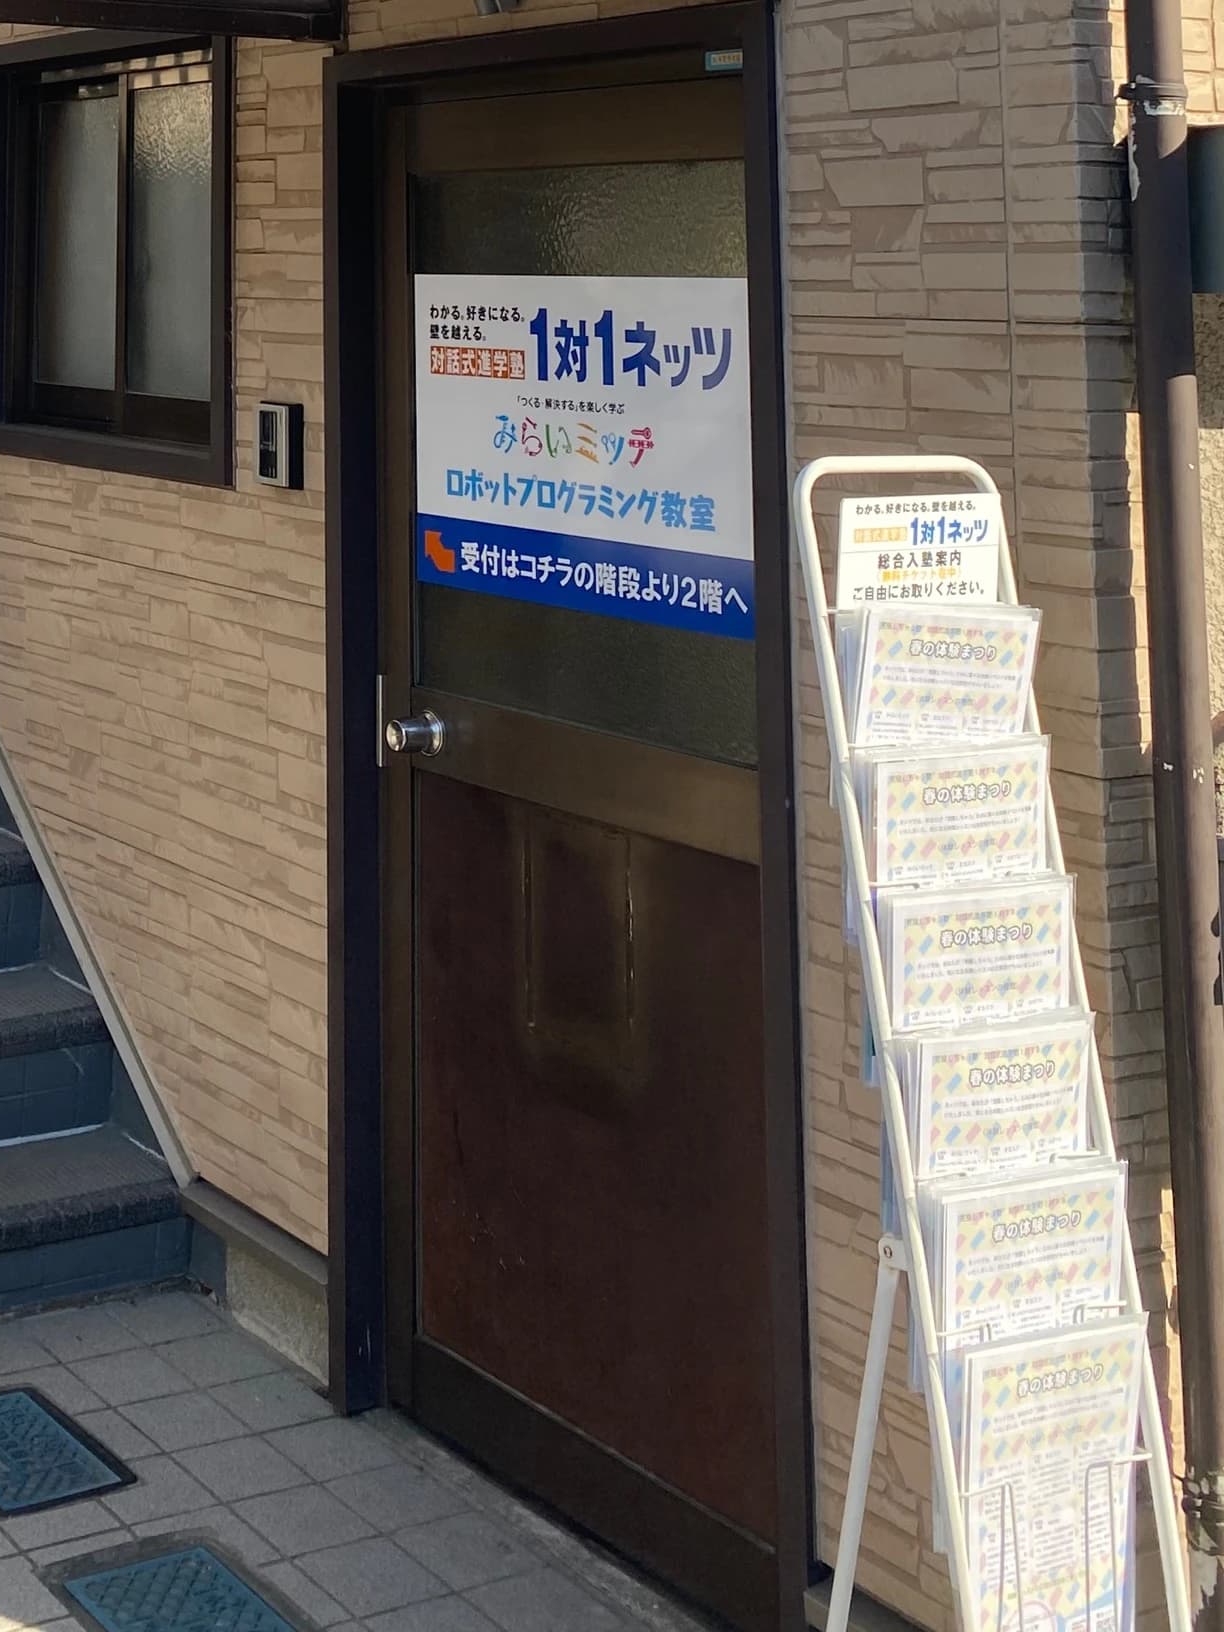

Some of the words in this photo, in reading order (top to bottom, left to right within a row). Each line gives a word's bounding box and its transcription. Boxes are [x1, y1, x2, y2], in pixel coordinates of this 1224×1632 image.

[429, 304, 525, 322] わかる。好きになる。
[429, 324, 487, 341] 壁を越える。
[431, 347, 525, 379] 対話式進学塾
[530, 308, 732, 391] 1対1ネッツ
[446, 469, 717, 532] ロボットプログラミング教室
[910, 516, 988, 546] 1対1ネッツ
[878, 550, 962, 570] 総合入塾案内
[460, 541, 749, 615] 受付はコチラの階段より2階へ
[853, 580, 985, 601] ご自由にお取りください。
[909, 638, 997, 662] 春の体験まつり
[923, 780, 1012, 806] 春の体験まつり
[940, 923, 1033, 948] 春の体験まつり
[969, 1060, 1056, 1088] 春の体験まつり
[992, 1210, 1082, 1244] 春の体験まつり
